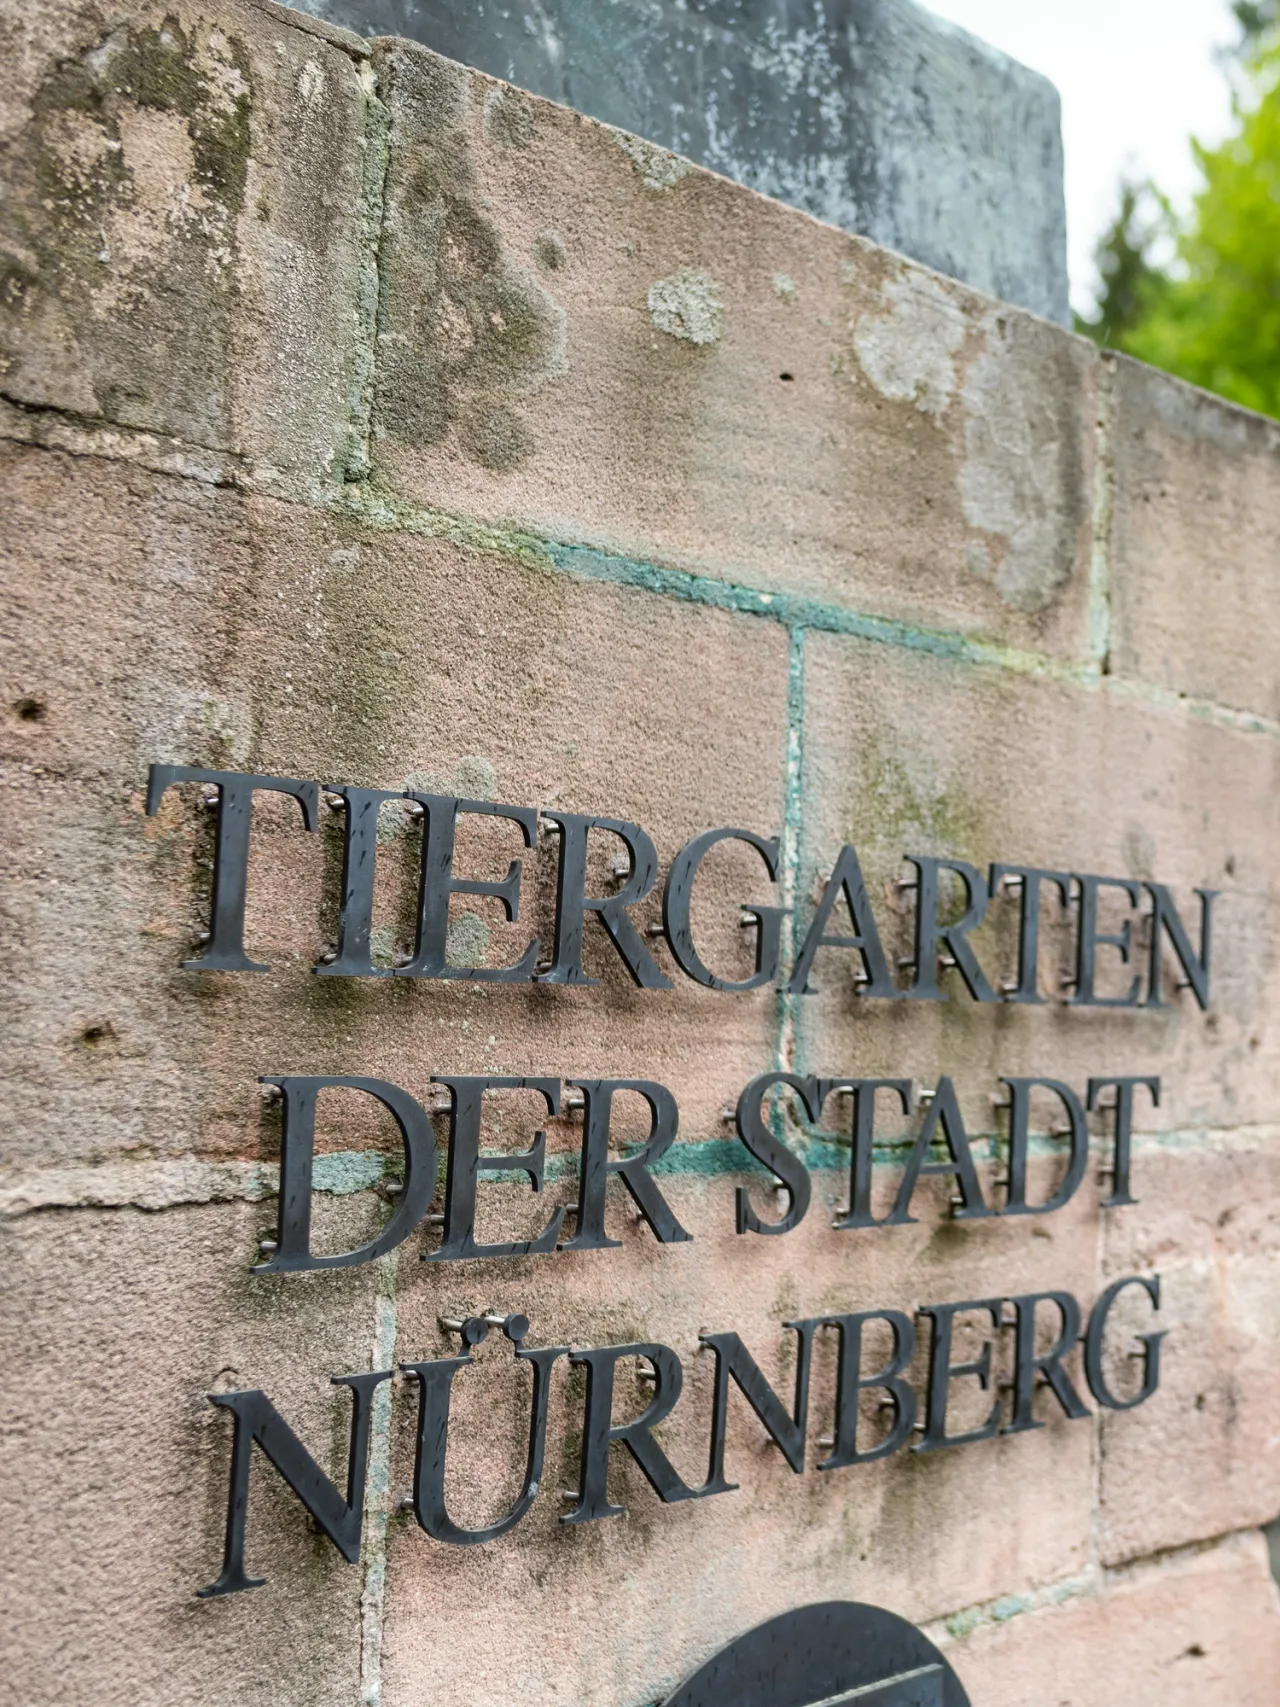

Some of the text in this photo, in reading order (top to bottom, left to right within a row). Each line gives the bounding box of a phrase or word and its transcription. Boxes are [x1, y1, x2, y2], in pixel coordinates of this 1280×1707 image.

[145, 764, 1221, 1010] TIERGARTEN
[250, 1071, 1160, 1274] DER STADT
[197, 1274, 1169, 1598] NÜRNBERG
